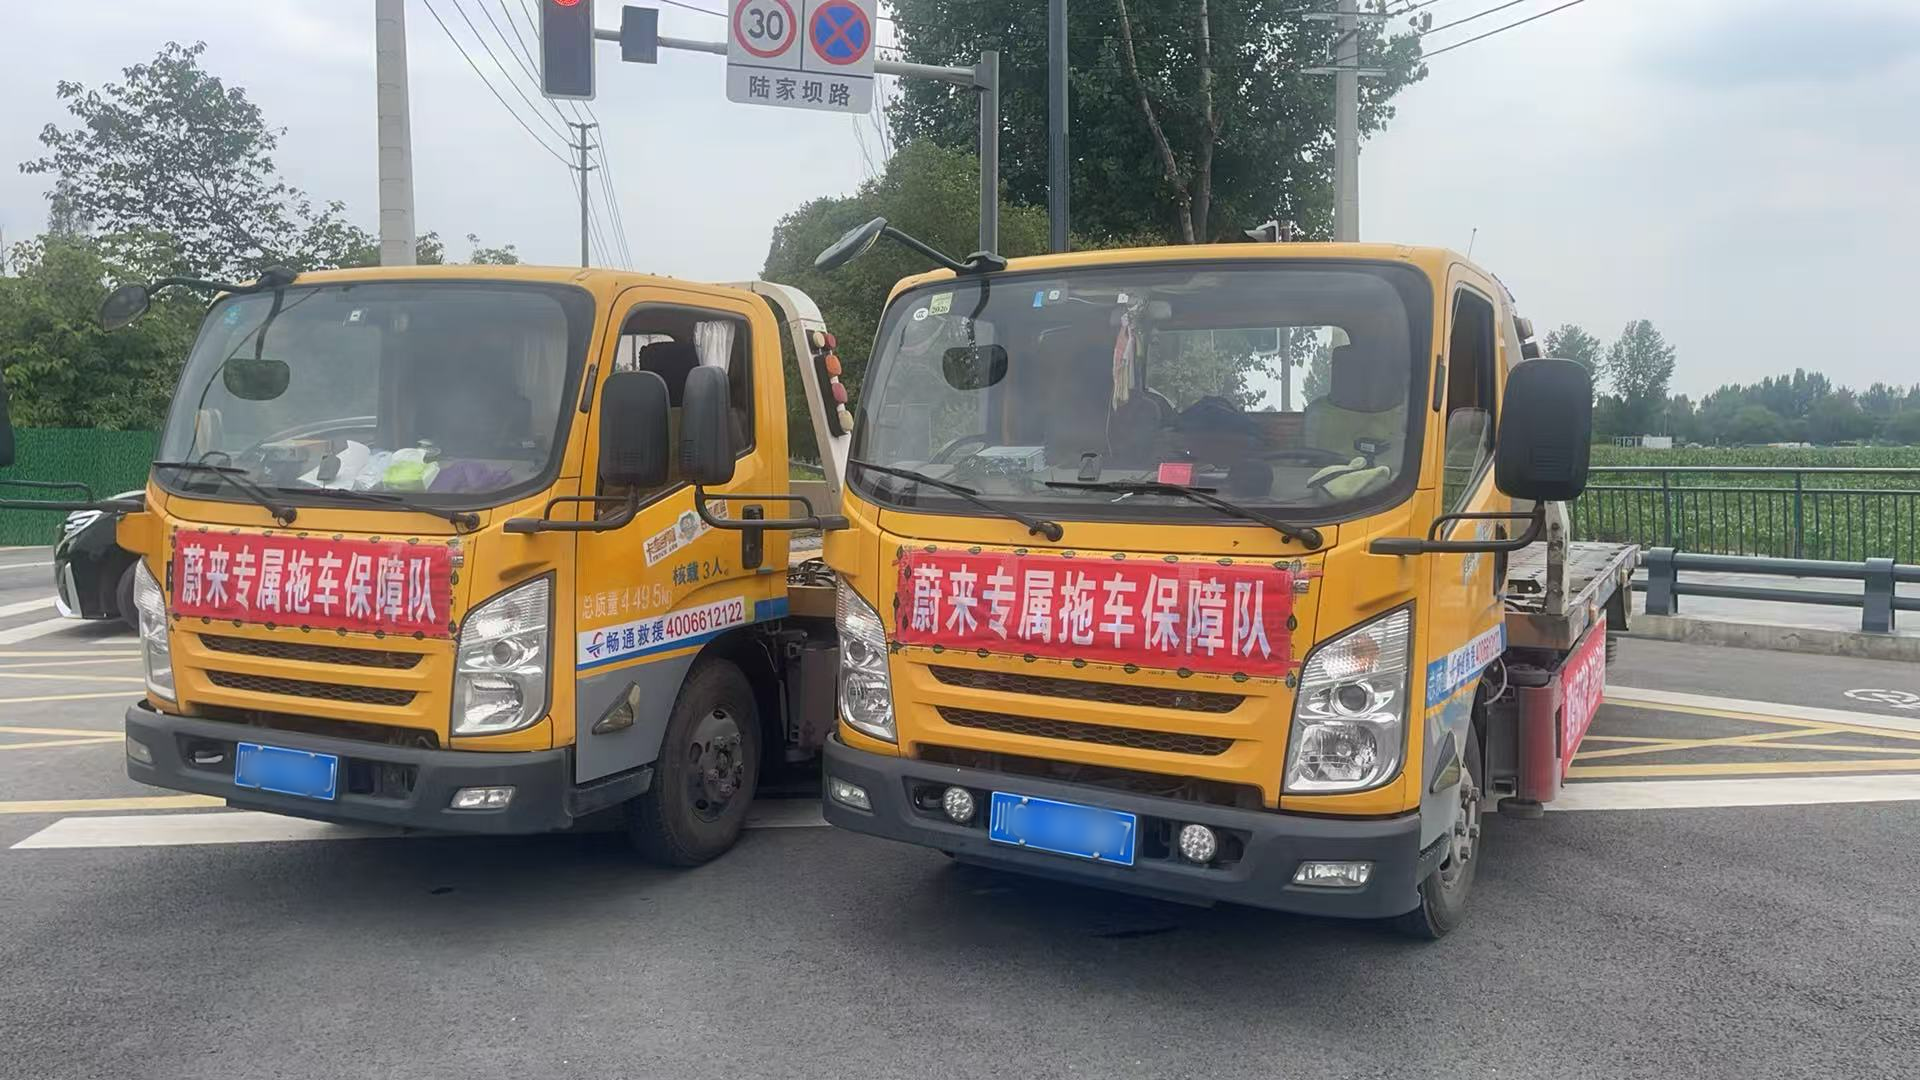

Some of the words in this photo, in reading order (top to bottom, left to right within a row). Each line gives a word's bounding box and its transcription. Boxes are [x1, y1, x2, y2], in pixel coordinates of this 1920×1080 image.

[748, 8, 783, 40] 30
[749, 75, 850, 106] 陆家坝路
[182, 543, 436, 623] 蔚来专属拖车保障队
[911, 562, 1272, 660] 蔚来专属拖车保障队
